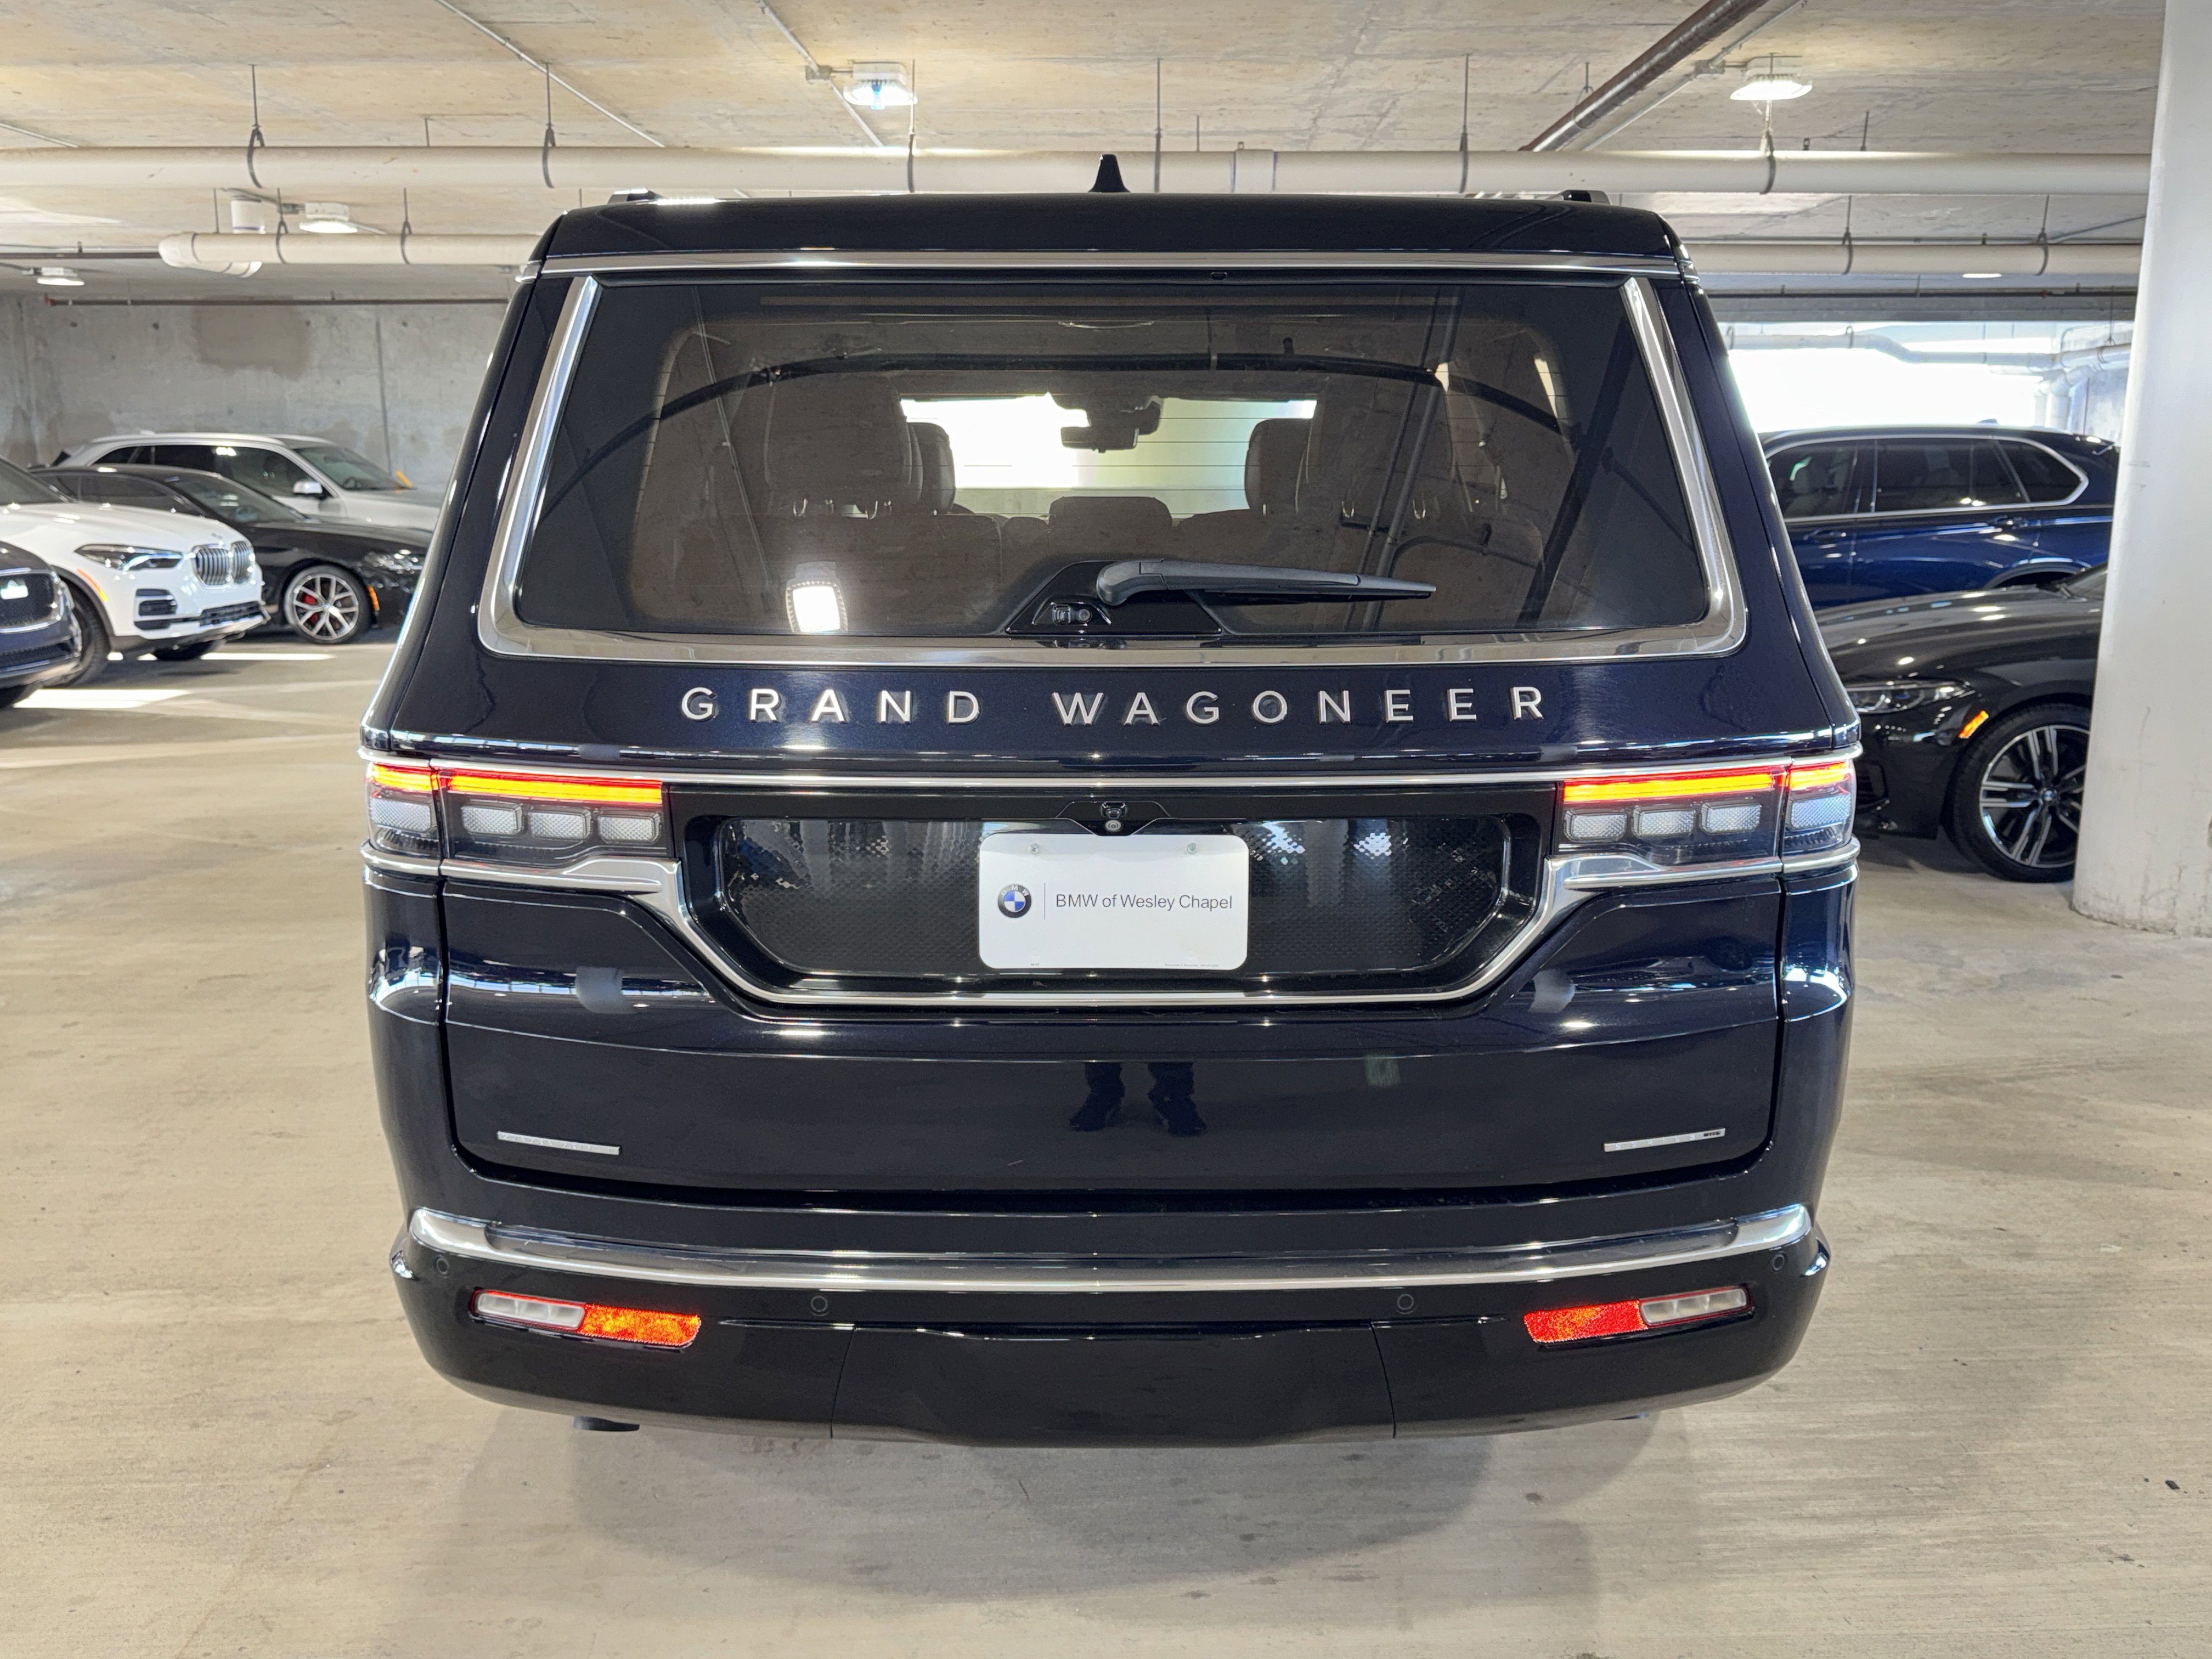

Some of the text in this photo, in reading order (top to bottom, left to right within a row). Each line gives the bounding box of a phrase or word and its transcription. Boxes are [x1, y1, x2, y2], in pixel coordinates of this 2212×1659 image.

[681, 685, 1544, 726] GRAND WAGONEER
[1000, 884, 1030, 896] BMW
[1056, 894, 1232, 912] BMW of Wesley Chapel
